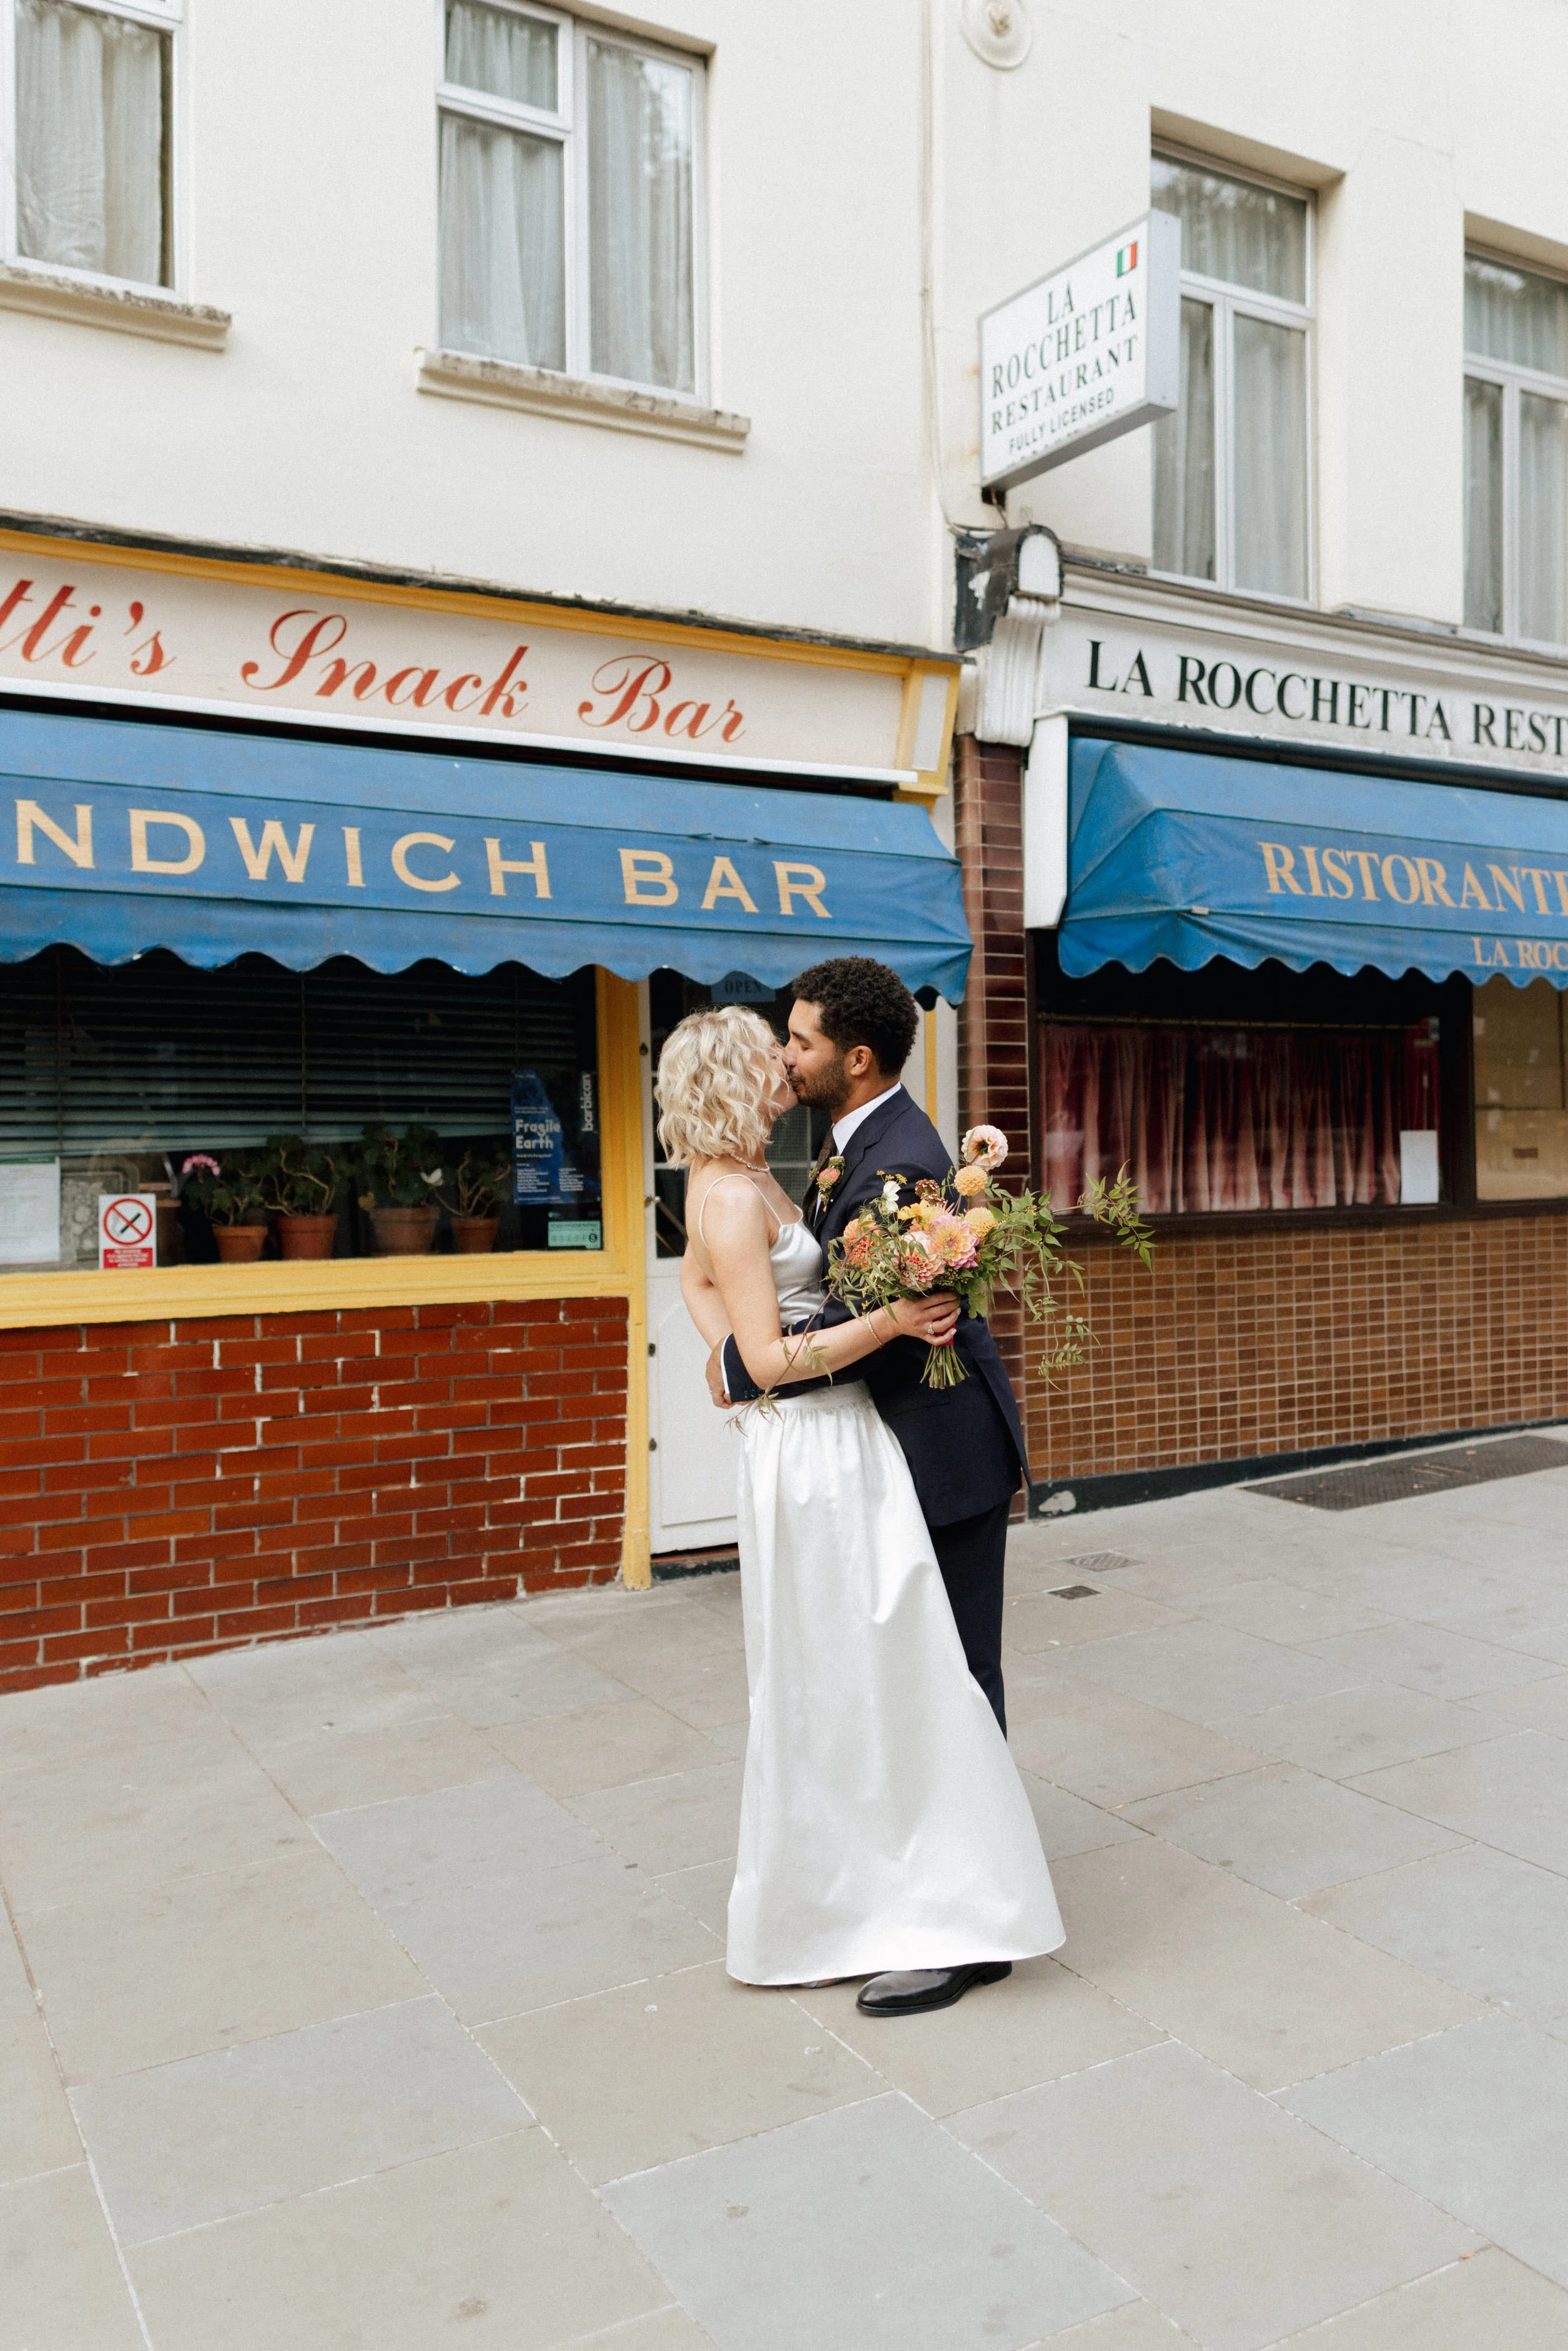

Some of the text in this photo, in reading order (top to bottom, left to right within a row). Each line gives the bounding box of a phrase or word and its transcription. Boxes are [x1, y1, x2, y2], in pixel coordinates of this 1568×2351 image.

[1047, 280, 1074, 325] LA
[992, 287, 1136, 400] ROCCHETTA
[992, 334, 1137, 435] RESTAURANT
[1009, 388, 1115, 454] FULLY LICENSED
[240, 608, 529, 718] Snack
[577, 654, 746, 743] Bar
[1086, 639, 1568, 756] LA ROCCHETTA REST
[14, 798, 834, 919] NDWICH BAR
[1471, 937, 1568, 971] LA ROC
[724, 980, 763, 994] OPEN
[515, 1118, 561, 1137] Fragile
[580, 1073, 593, 1132] barbican
[515, 1135, 553, 1150] Earth
